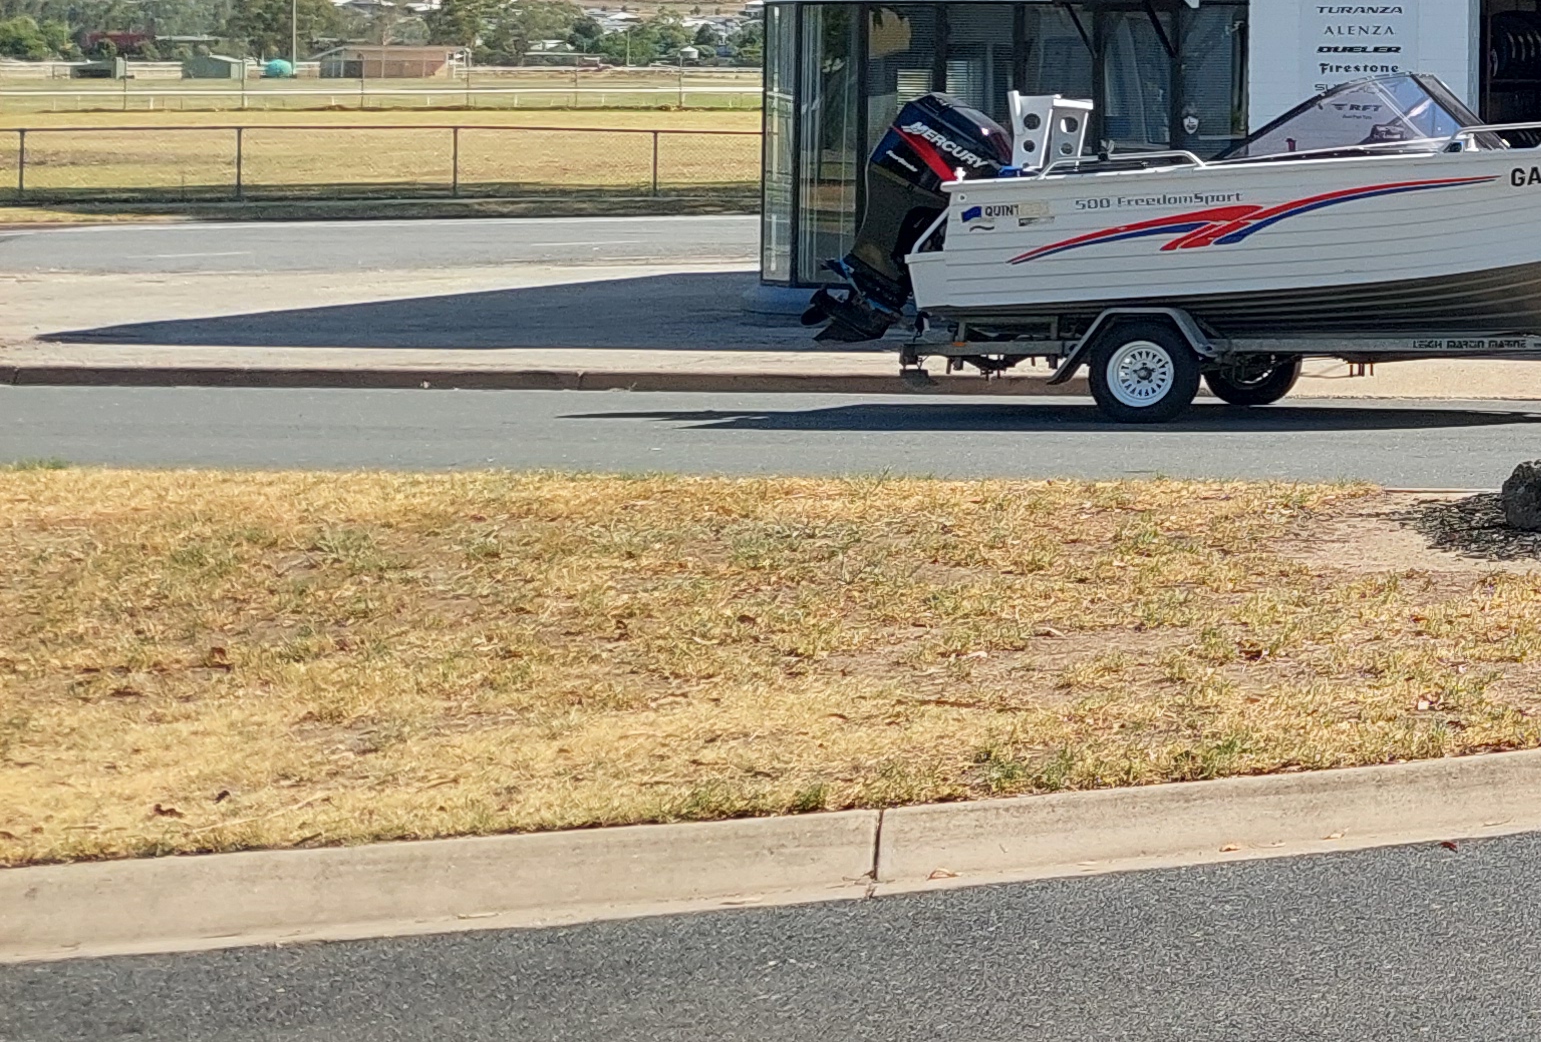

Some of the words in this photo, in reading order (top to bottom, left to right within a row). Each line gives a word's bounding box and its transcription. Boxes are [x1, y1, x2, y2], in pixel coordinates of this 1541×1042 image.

[1316, 6, 1403, 14] TURANZA
[1323, 25, 1396, 37] ALENZA
[1318, 62, 1400, 75] Firestone
[901, 121, 989, 169] MERCURY
[1075, 198, 1111, 210] 500
